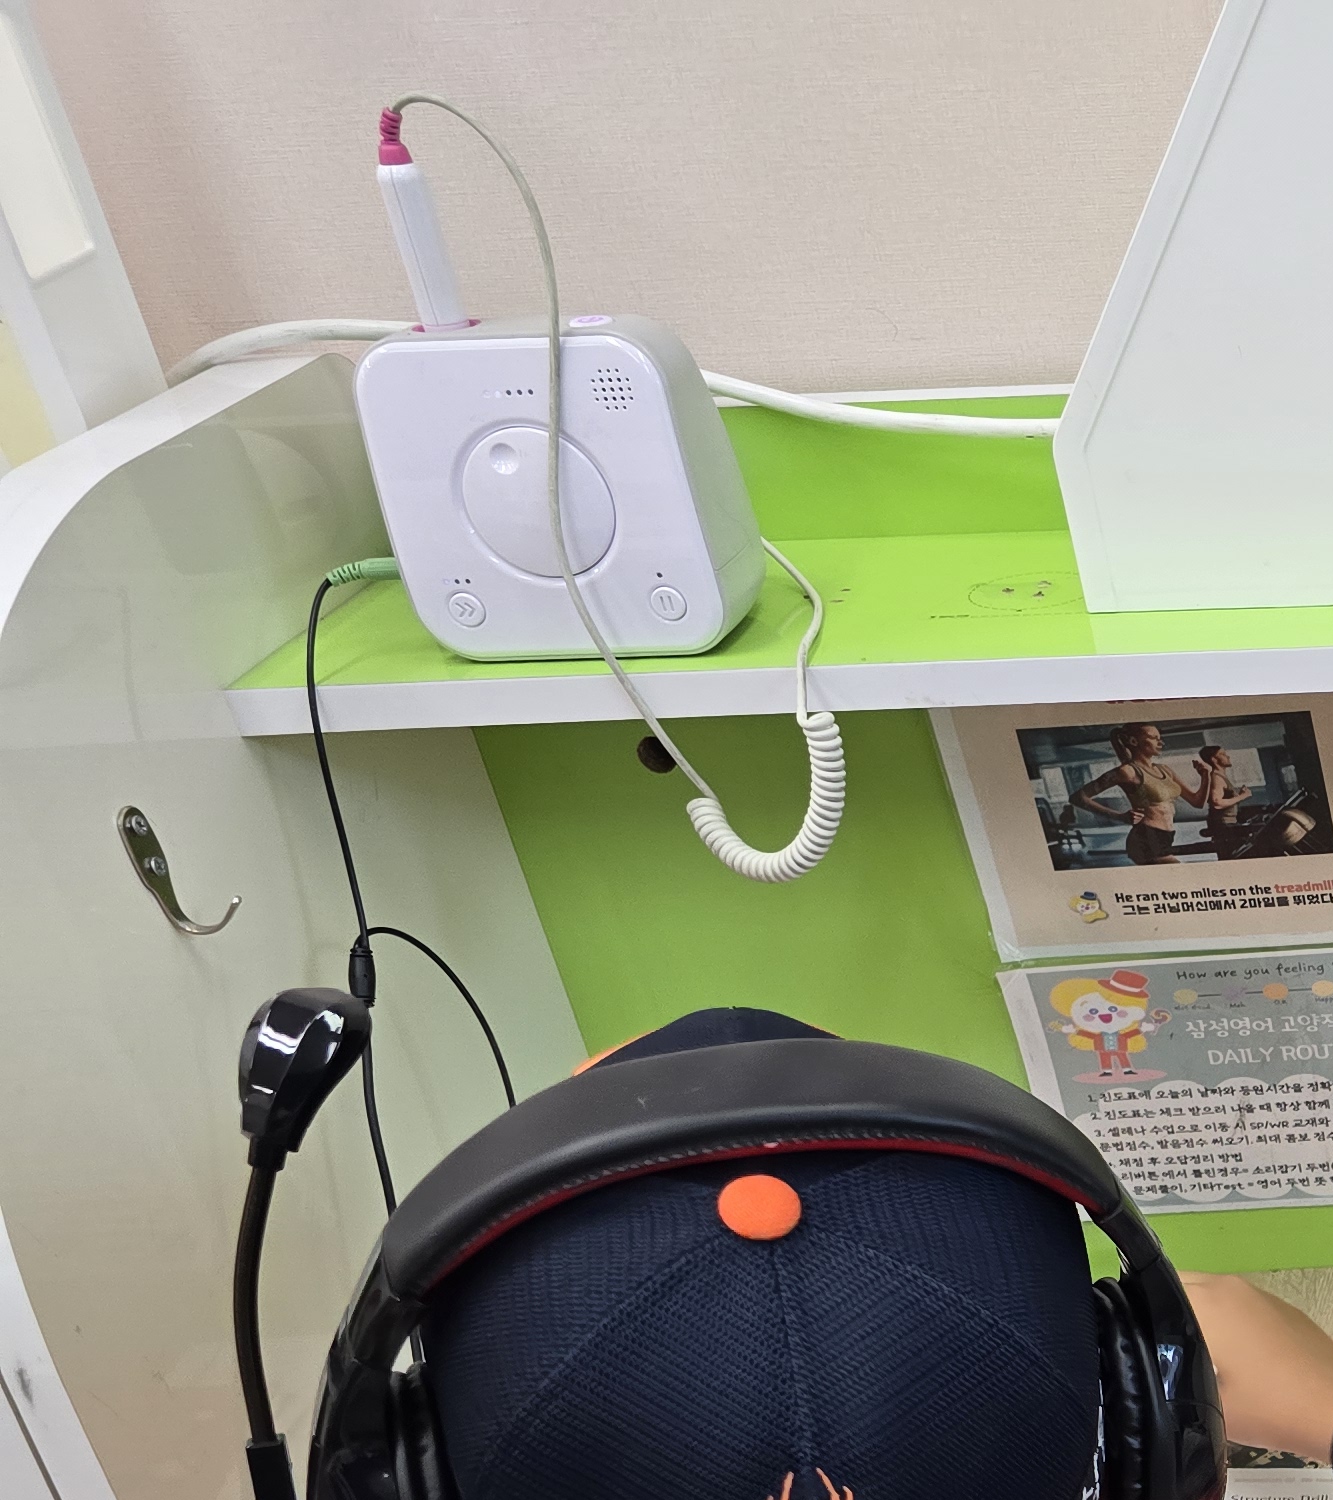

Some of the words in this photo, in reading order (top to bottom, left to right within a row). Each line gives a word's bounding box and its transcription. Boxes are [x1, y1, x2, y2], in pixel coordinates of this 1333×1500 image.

[1115, 893, 1134, 903] He
[1136, 892, 1159, 902] ran
[1161, 891, 1188, 901] two
[1191, 888, 1227, 899] miles
[1230, 887, 1246, 896] on
[1249, 884, 1272, 895] the
[1122, 904, 1150, 915] 그는
[1153, 898, 1236, 914] 러닝머신에서
[1176, 969, 1206, 981] How
[1214, 968, 1237, 978] are
[1243, 967, 1270, 980] you
[1276, 962, 1325, 976] feeling
[1185, 1016, 1274, 1039] 삼성영어
[1207, 1046, 1274, 1065] DAILY
[1100, 1090, 1151, 1101] 진도표에
[1155, 1088, 1193, 1100] 오늘의
[1198, 1086, 1236, 1098] 날짜와
[1104, 1110, 1156, 1121] 진도표는
[1159, 1107, 1186, 1117] 체크
[1259, 1102, 1271, 1112] 때
[1275, 1101, 1301, 1112] 항상
[1150, 1124, 1202, 1135] 수업으로
[1250, 1120, 1289, 1129] SP/WR
[1292, 1116, 1331, 1128] 교재와
